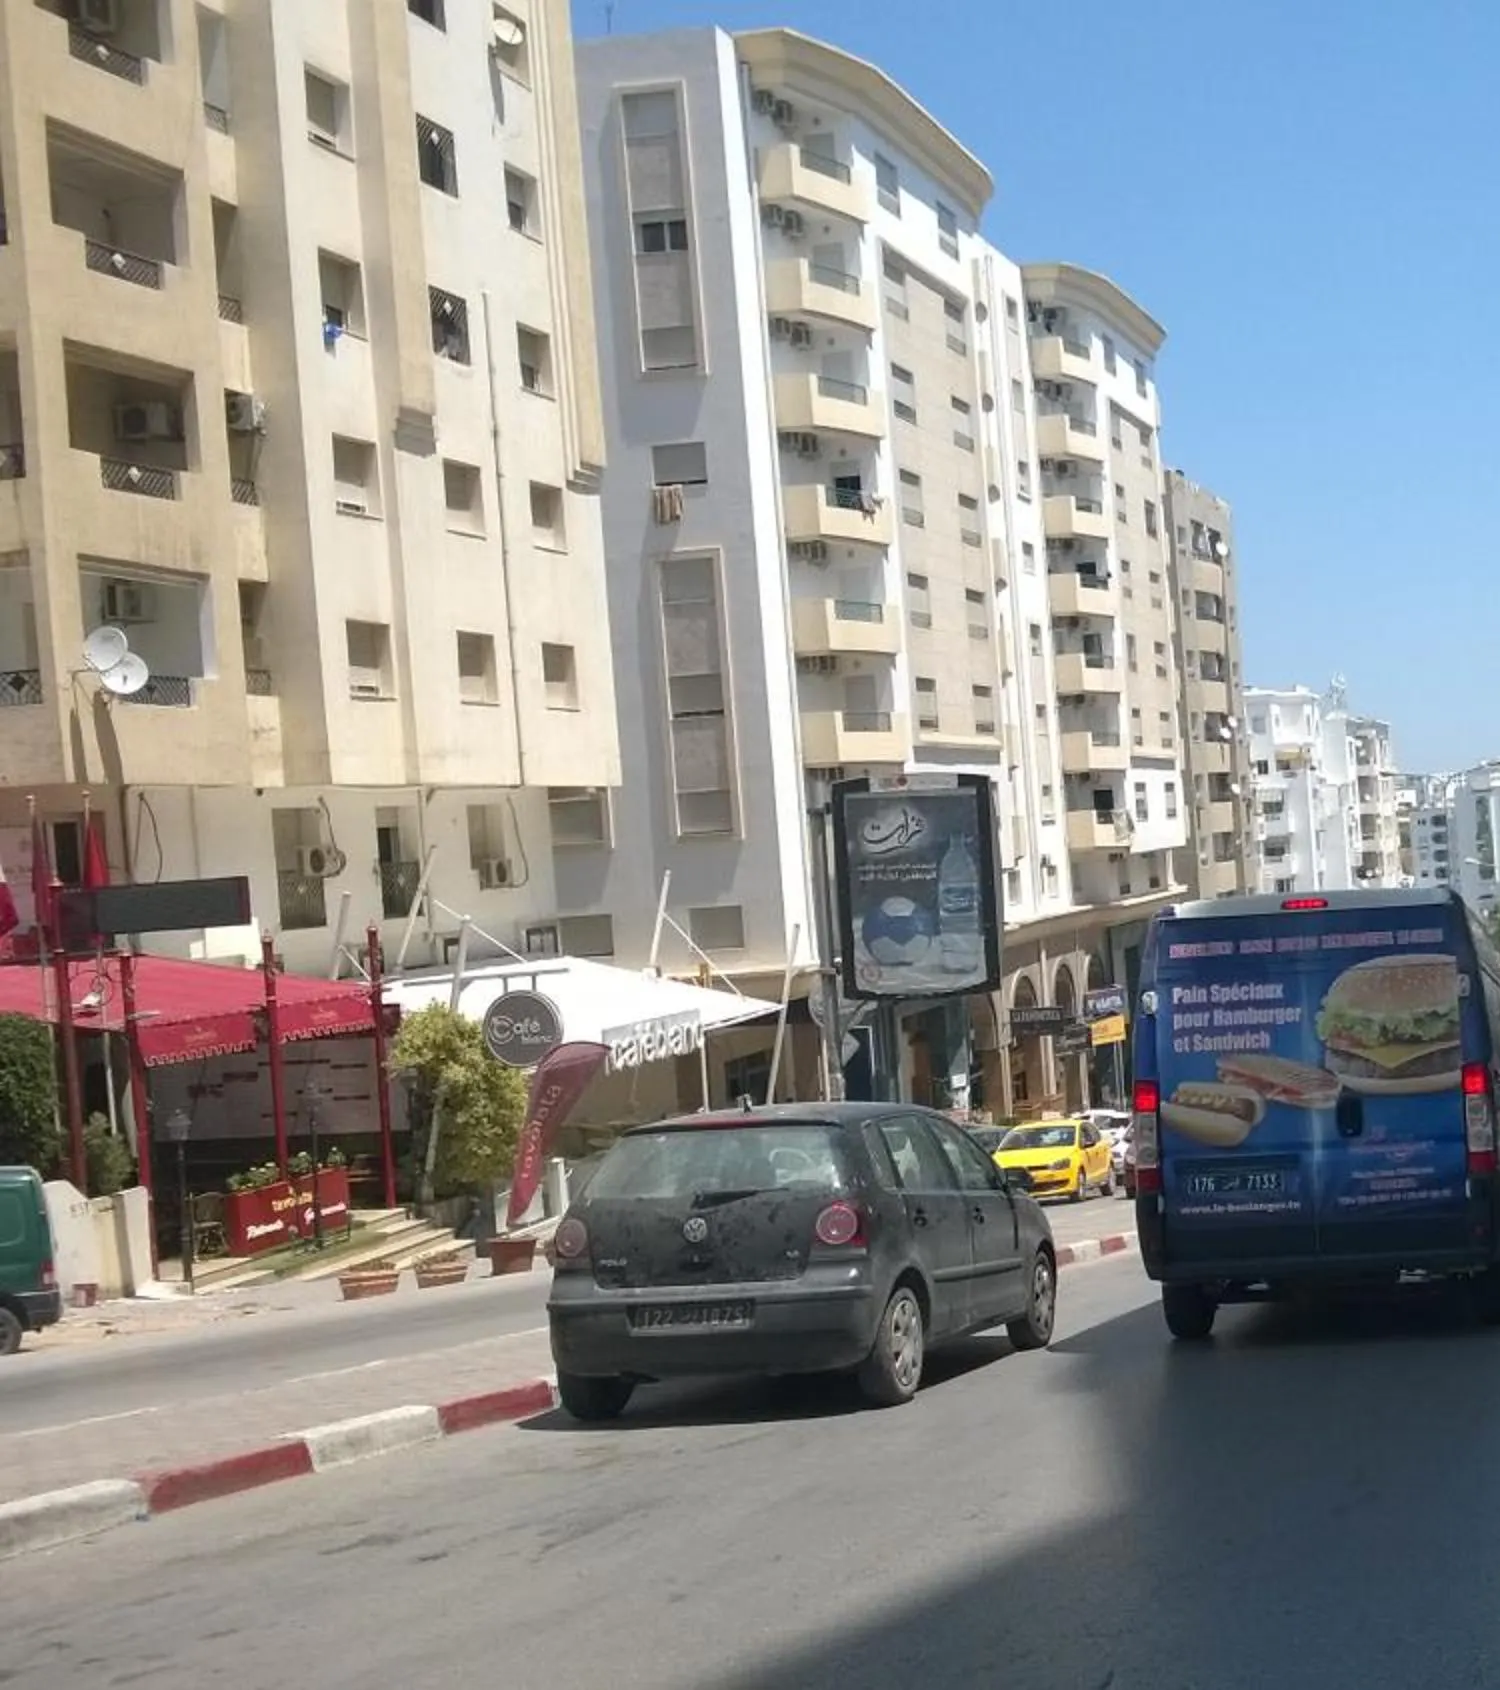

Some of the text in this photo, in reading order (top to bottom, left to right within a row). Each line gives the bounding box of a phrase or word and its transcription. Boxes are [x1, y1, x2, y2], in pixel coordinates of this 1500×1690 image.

[1172, 983, 1283, 1005] Pain Spéciaux
[1173, 1007, 1301, 1031] pour Hamburger
[1173, 1031, 1270, 1053] et Sandwich
